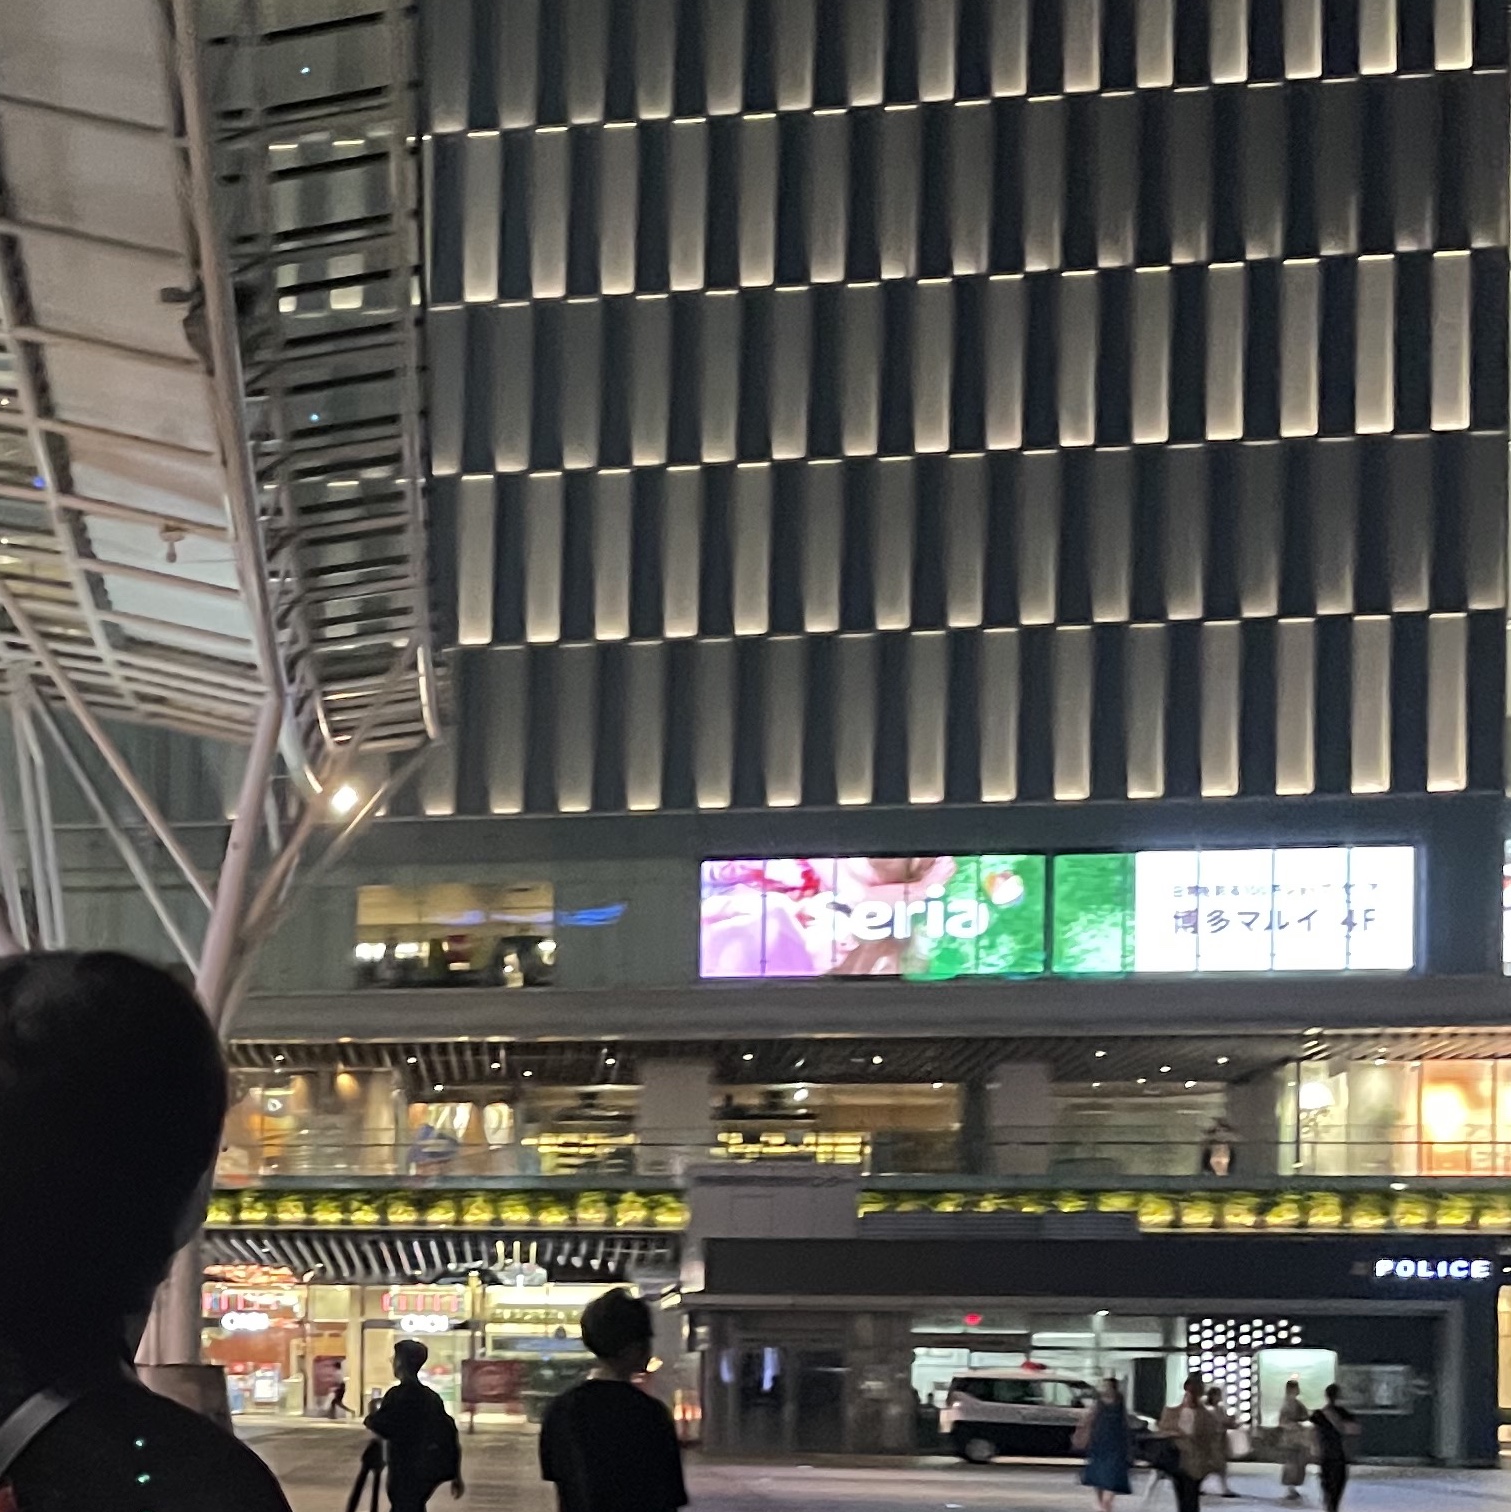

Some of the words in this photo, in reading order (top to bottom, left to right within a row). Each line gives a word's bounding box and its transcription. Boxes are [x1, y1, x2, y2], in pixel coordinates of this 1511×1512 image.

[1173, 908, 1319, 934] 博多マルイ
[1375, 1258, 1492, 1279] POLICE
